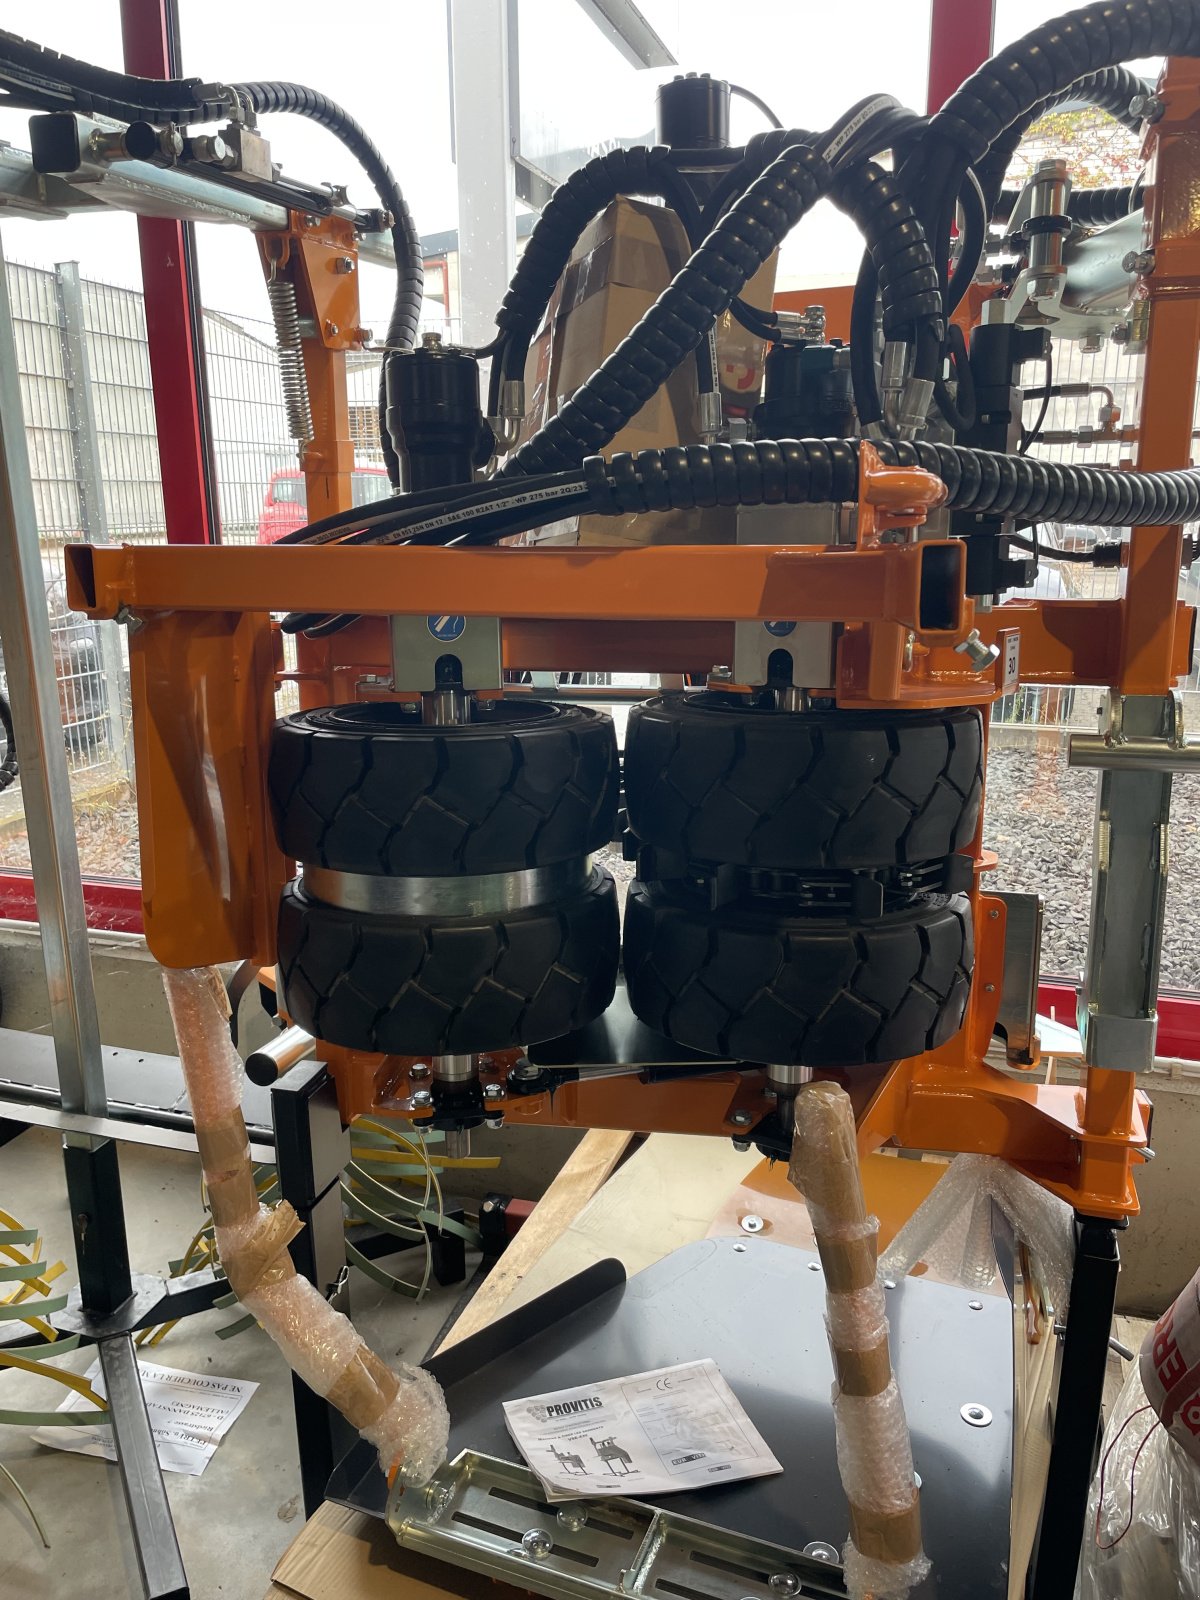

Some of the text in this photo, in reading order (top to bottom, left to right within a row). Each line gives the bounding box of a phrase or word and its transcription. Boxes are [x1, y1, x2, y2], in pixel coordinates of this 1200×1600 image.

[425, 522, 435, 530] DN
[447, 513, 461, 522] SAE
[461, 509, 475, 518] 100
[515, 496, 527, 504] WP
[528, 492, 544, 501] 275
[545, 489, 558, 498] bar
[1008, 656, 1016, 675] 30
[166, 1373, 211, 1389] COUCHER
[211, 1382, 229, 1391] PAS
[228, 1384, 244, 1393] NE
[546, 1396, 604, 1417] PROVITIS
